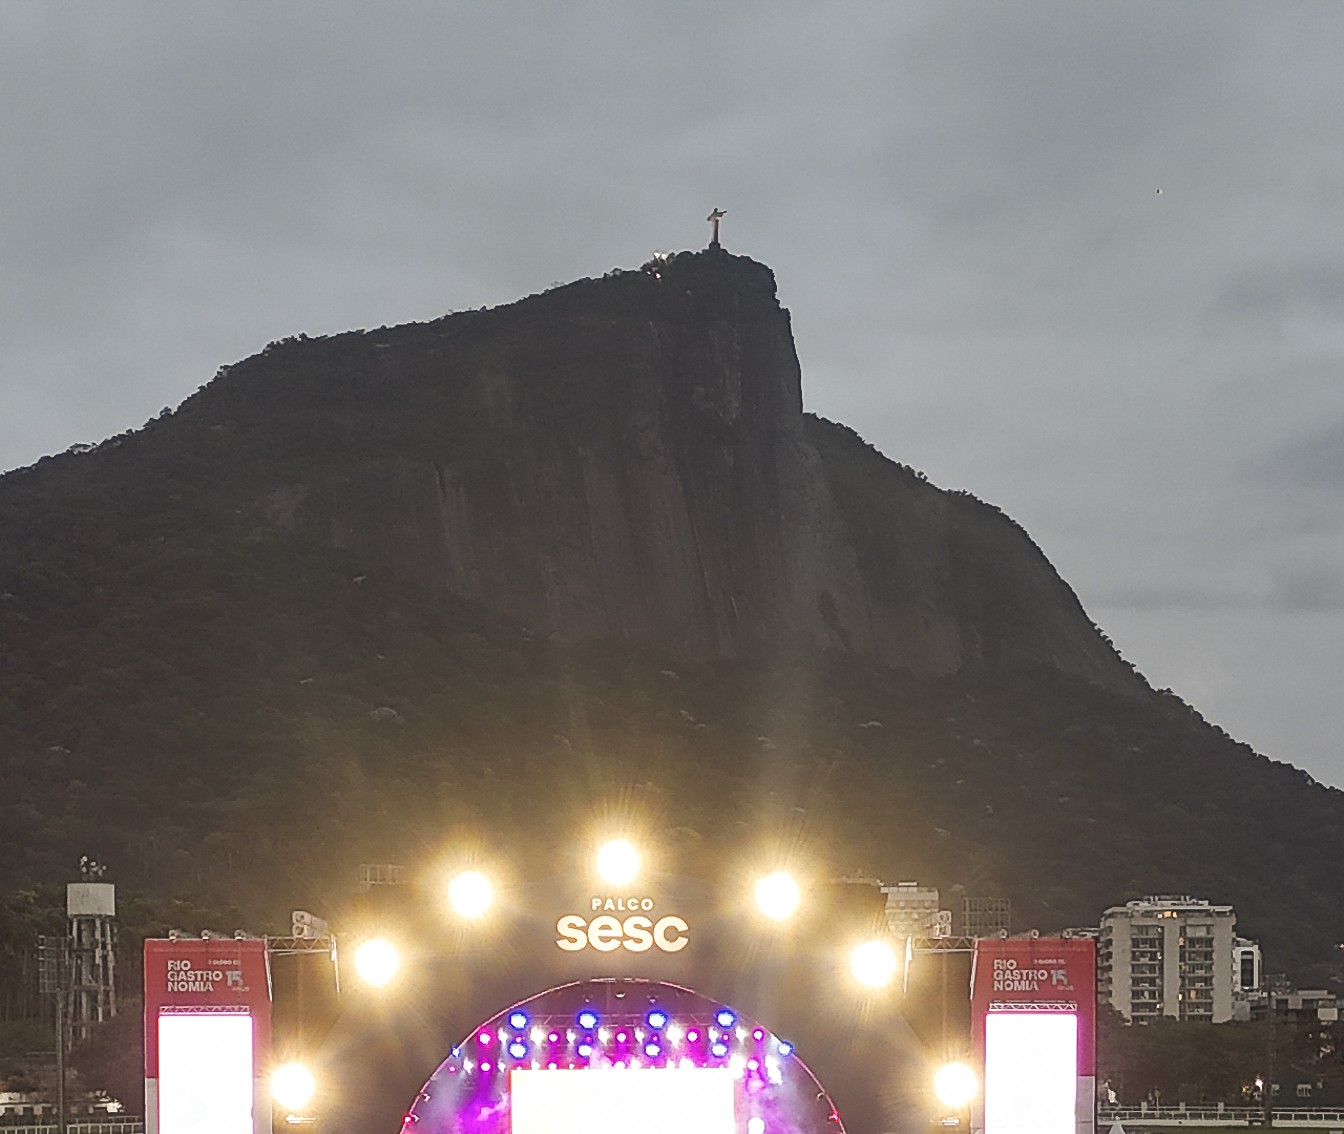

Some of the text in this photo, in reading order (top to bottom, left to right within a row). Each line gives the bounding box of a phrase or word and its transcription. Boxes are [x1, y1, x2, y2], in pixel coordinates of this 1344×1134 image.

[591, 898, 654, 911] PALCO
[556, 915, 689, 952] sesc
[168, 960, 191, 970] RIO
[993, 959, 1016, 969] RIO
[168, 971, 223, 981] GASTRO
[993, 969, 1048, 980] GASTRO
[168, 982, 213, 992] NOMIA
[993, 980, 1039, 991] NOMIA
